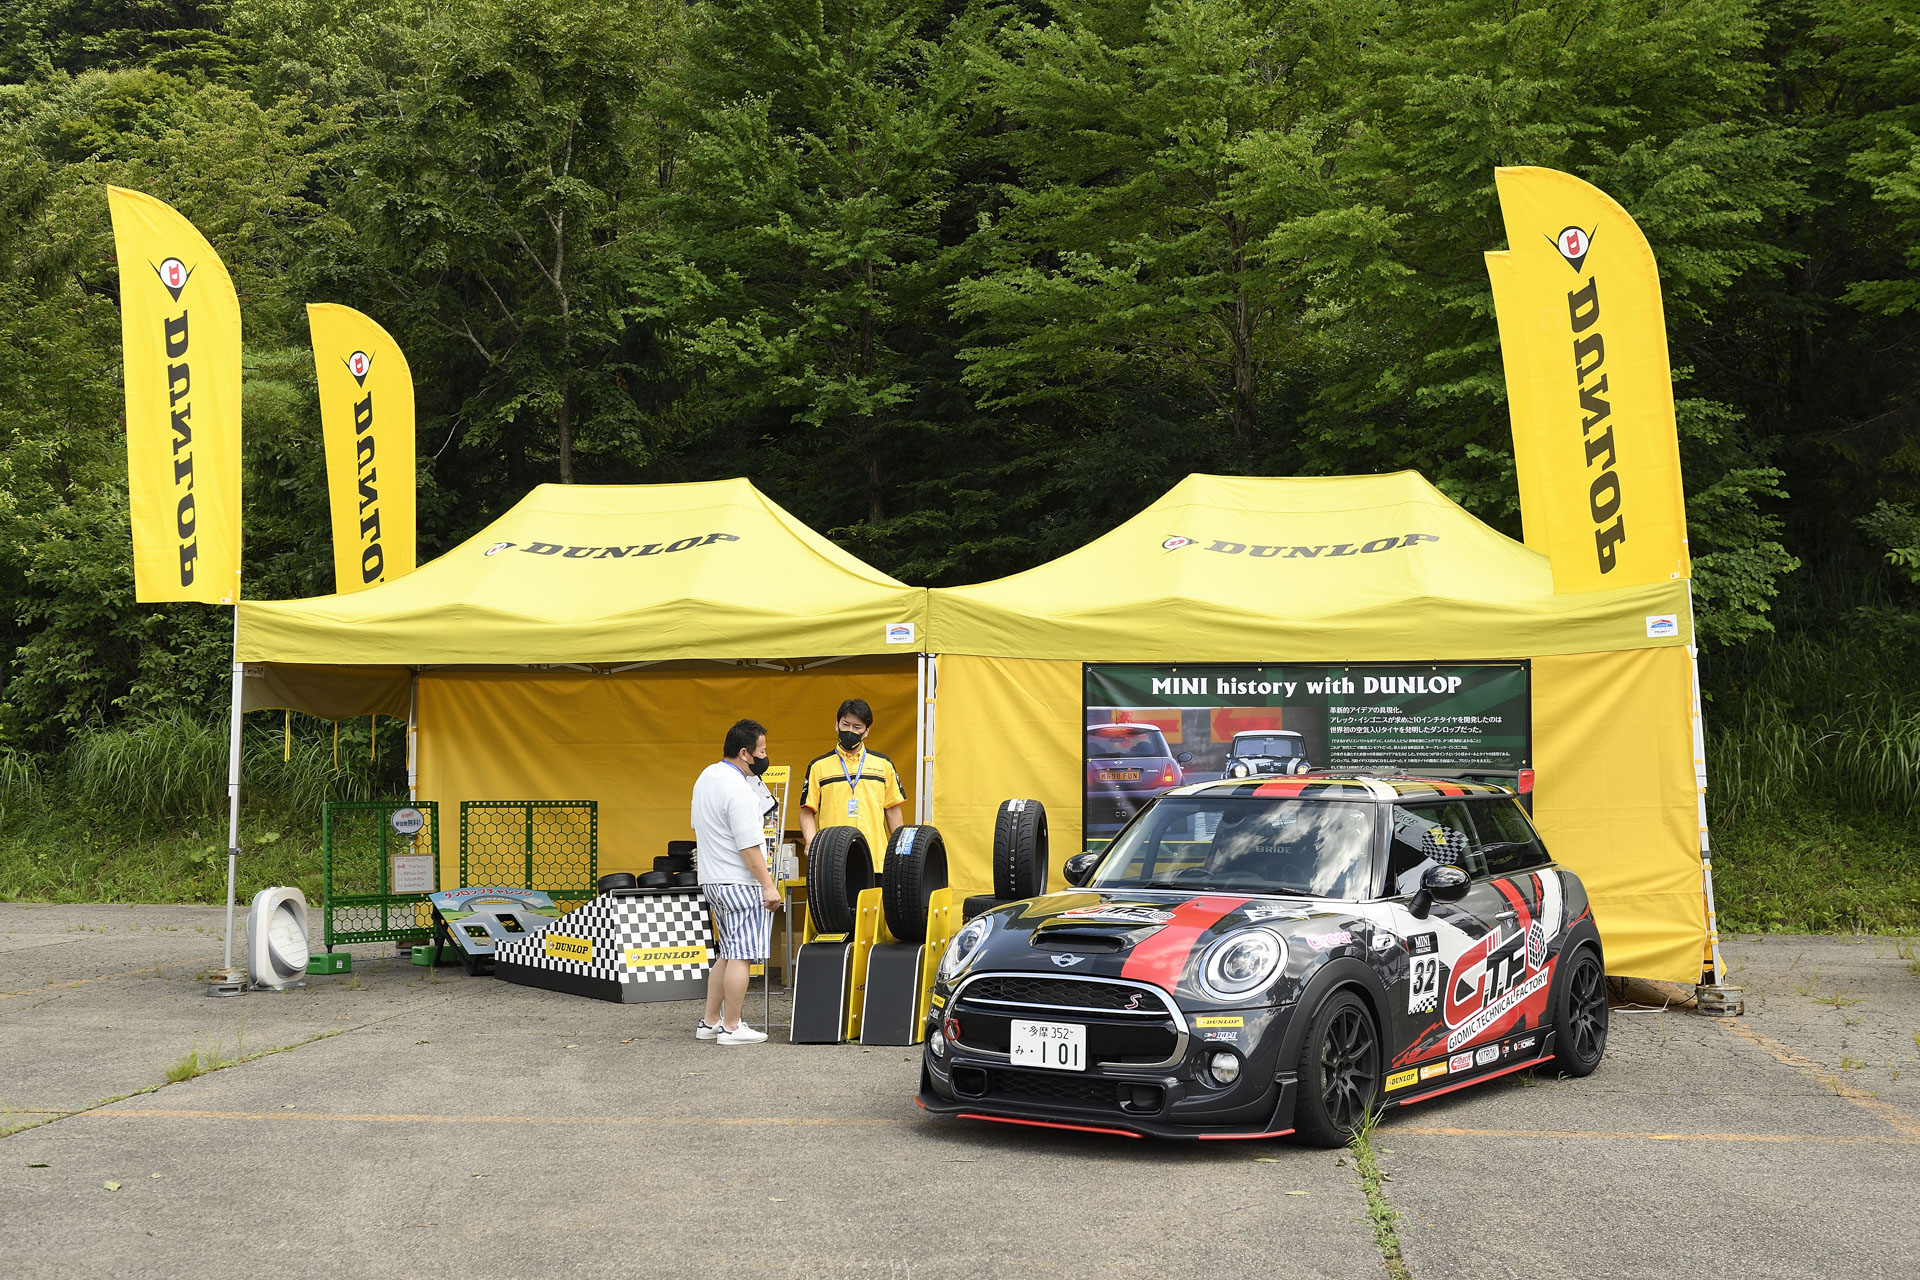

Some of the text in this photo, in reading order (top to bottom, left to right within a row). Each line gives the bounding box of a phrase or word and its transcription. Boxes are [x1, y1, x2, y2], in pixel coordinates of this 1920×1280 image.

[520, 532, 741, 559] DUNLOP
[1204, 533, 1440, 559] DUNLOP
[1151, 676, 1463, 698] MINI history with DUNLOP
[1256, 844, 1292, 855] BRIDE
[554, 941, 589, 955] DUNLOP
[1414, 934, 1432, 948] MINI
[642, 950, 701, 961] DUNLOP
[1413, 957, 1437, 997] 32
[1449, 971, 1548, 1050] GIOMIC TECHNICAL FACTORY
[1206, 1018, 1241, 1026] DUNLOP
[1028, 1025, 1069, 1041] 多摩 352
[1015, 1045, 1025, 1056] み
[1391, 1073, 1415, 1087] DUNLOP
